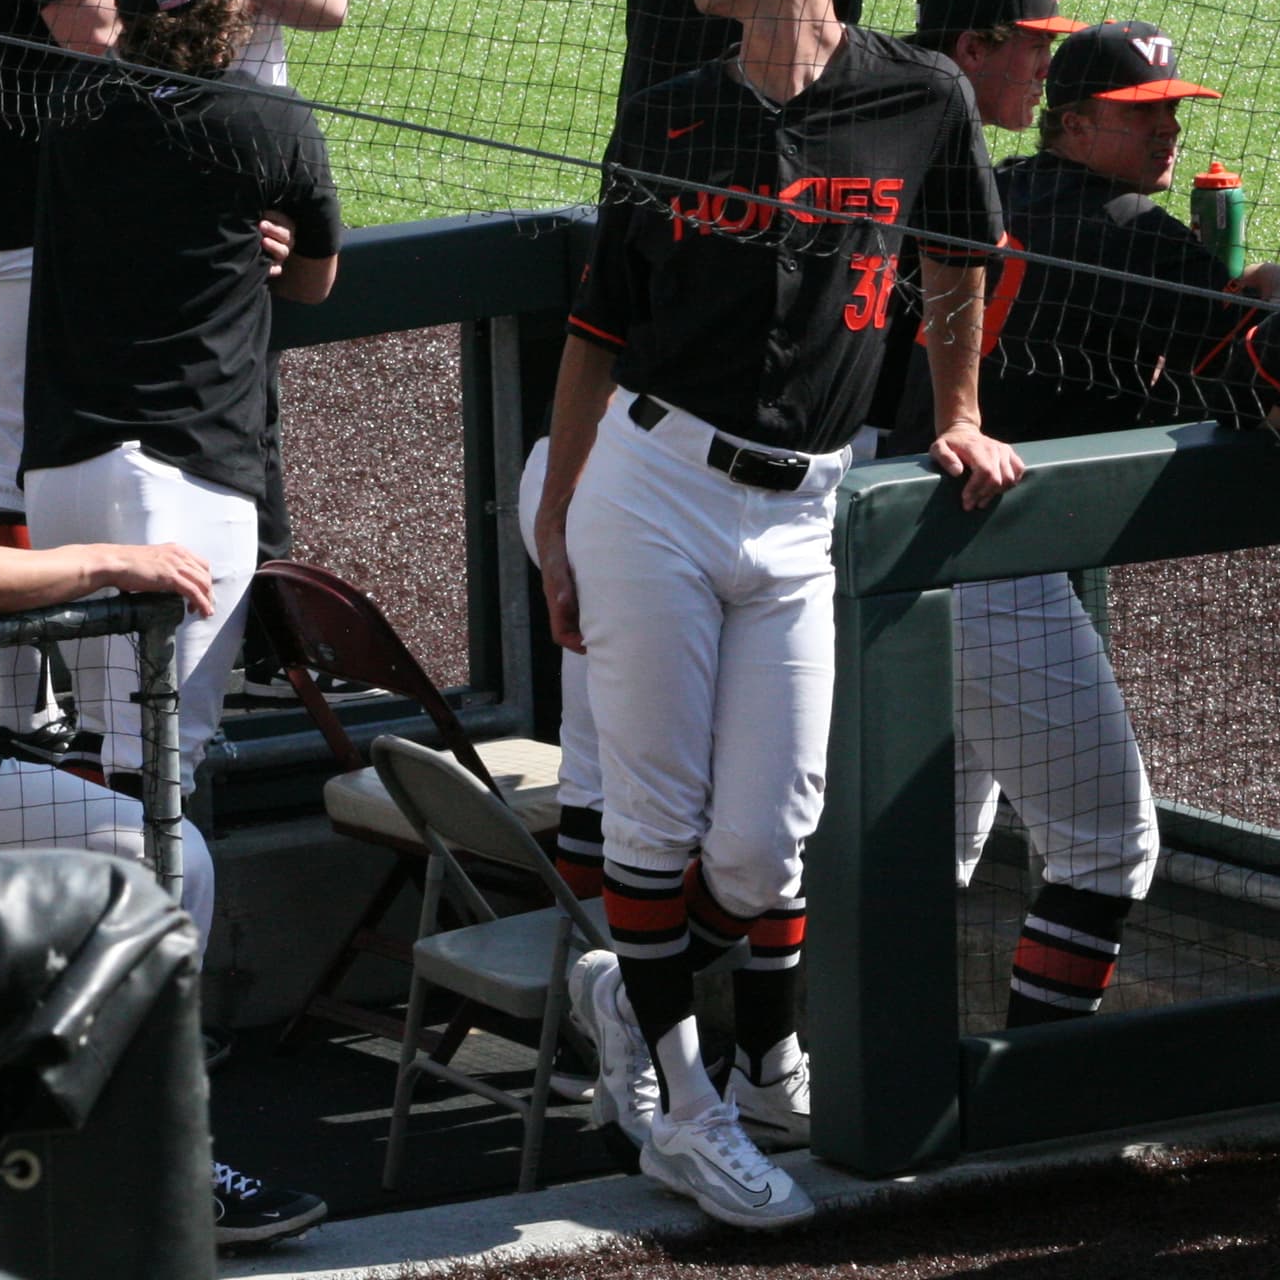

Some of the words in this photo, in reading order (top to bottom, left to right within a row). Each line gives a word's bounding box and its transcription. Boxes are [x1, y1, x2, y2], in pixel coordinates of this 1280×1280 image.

[1131, 36, 1173, 66] VT
[670, 177, 905, 242] HOKIES
[843, 252, 899, 332] 31
